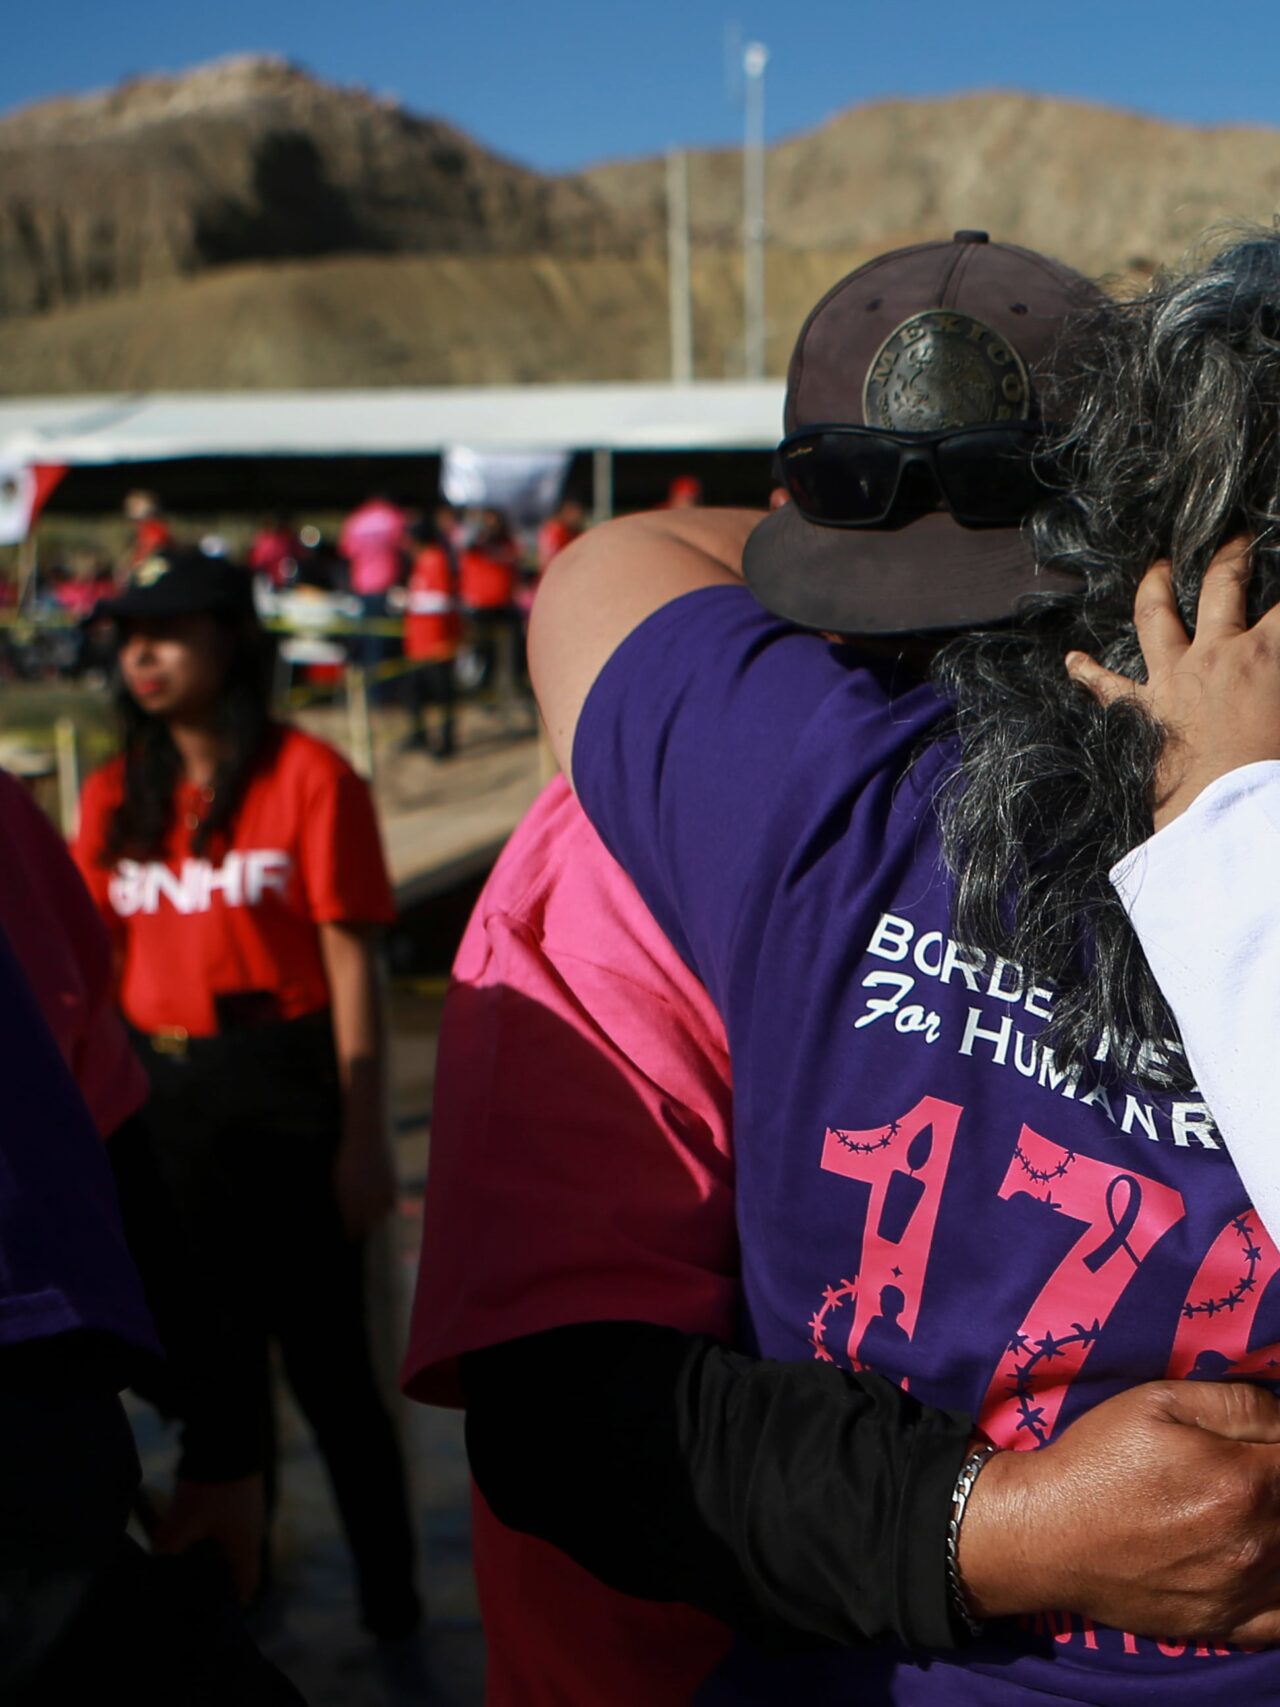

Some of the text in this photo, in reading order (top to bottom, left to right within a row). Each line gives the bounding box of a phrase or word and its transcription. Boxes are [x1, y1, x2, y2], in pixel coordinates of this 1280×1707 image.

[873, 315, 1022, 402] MEXICO
[866, 912, 1054, 1023] BORDE
[854, 970, 941, 1044] For
[957, 1006, 1160, 1142] HUMAN
